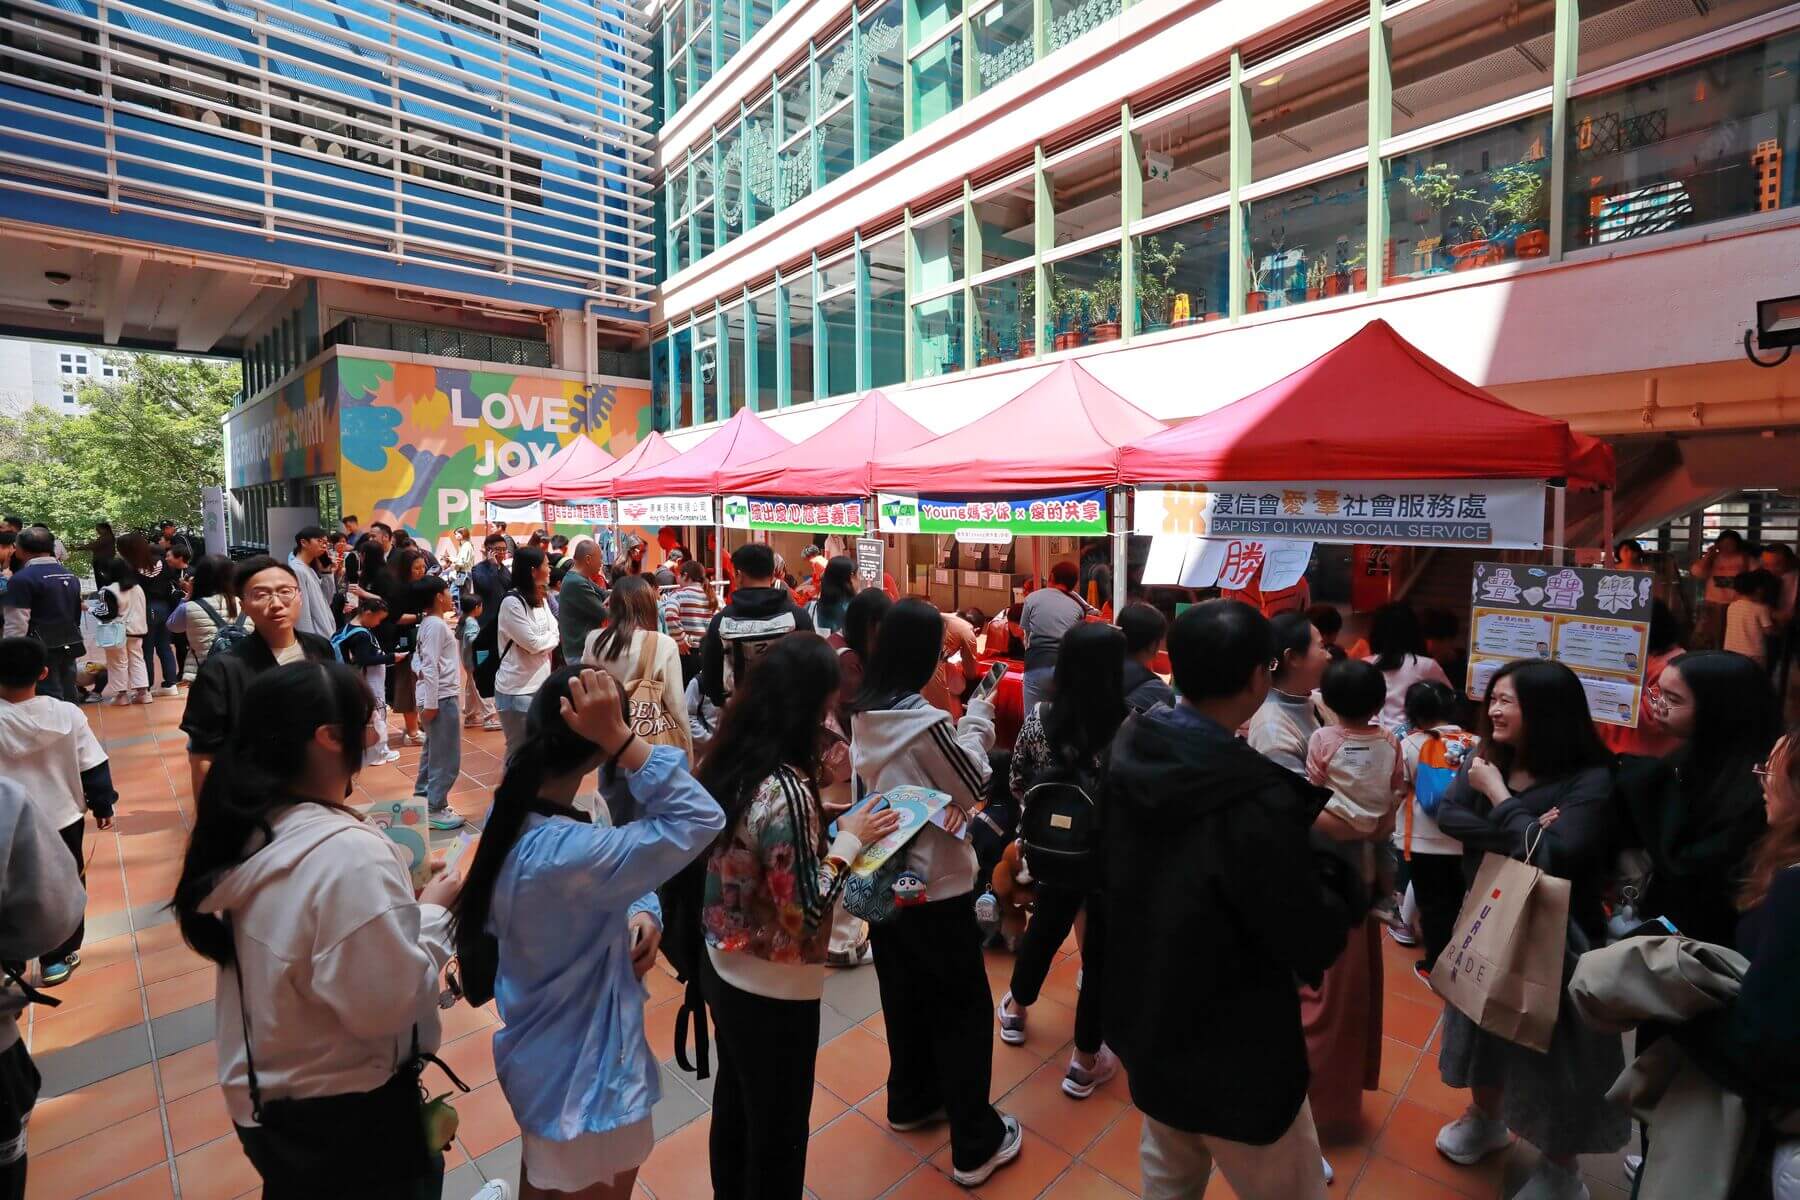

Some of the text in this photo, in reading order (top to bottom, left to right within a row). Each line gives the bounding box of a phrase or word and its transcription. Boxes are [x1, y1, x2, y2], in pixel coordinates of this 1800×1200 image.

[292, 396, 325, 451] SPIRIT
[451, 388, 568, 434] LOVE
[473, 440, 556, 477] JOY
[886, 505, 911, 516] YWCA
[1031, 502, 1098, 520] 愛的共享
[1213, 520, 1488, 539] BAPTIST OI KWAN SOCIAL SERVICE
[1220, 540, 1264, 585] 勝
[1451, 904, 1491, 983] URBAN
